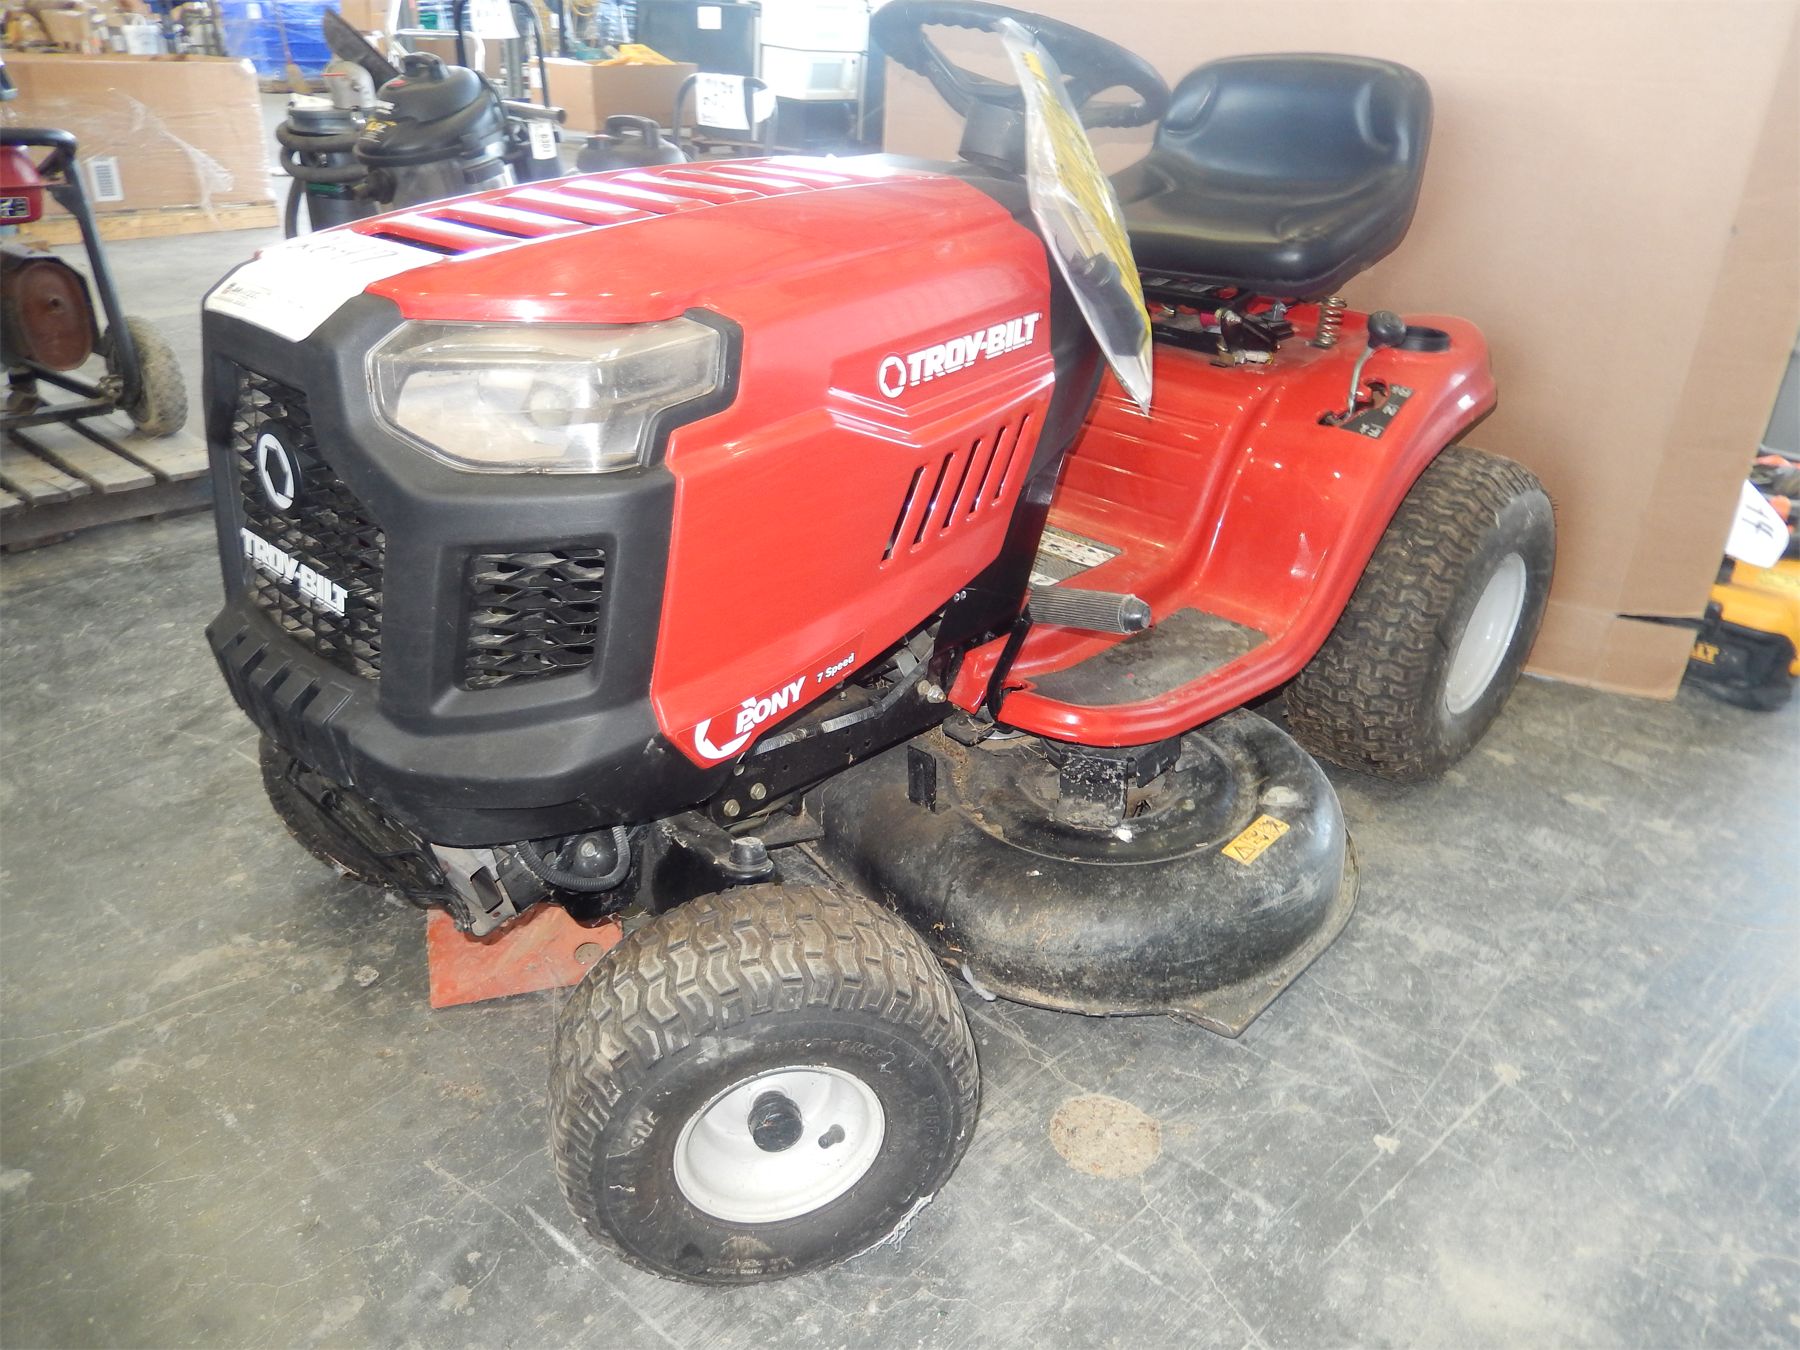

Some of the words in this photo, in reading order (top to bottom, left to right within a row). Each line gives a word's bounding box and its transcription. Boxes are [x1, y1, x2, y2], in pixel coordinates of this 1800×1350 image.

[907, 312, 1040, 387] TROY-BILT
[240, 527, 348, 617] TROY-BILT
[735, 675, 806, 735] PONY
[816, 672, 824, 684] 7
[825, 652, 855, 679] Speed
